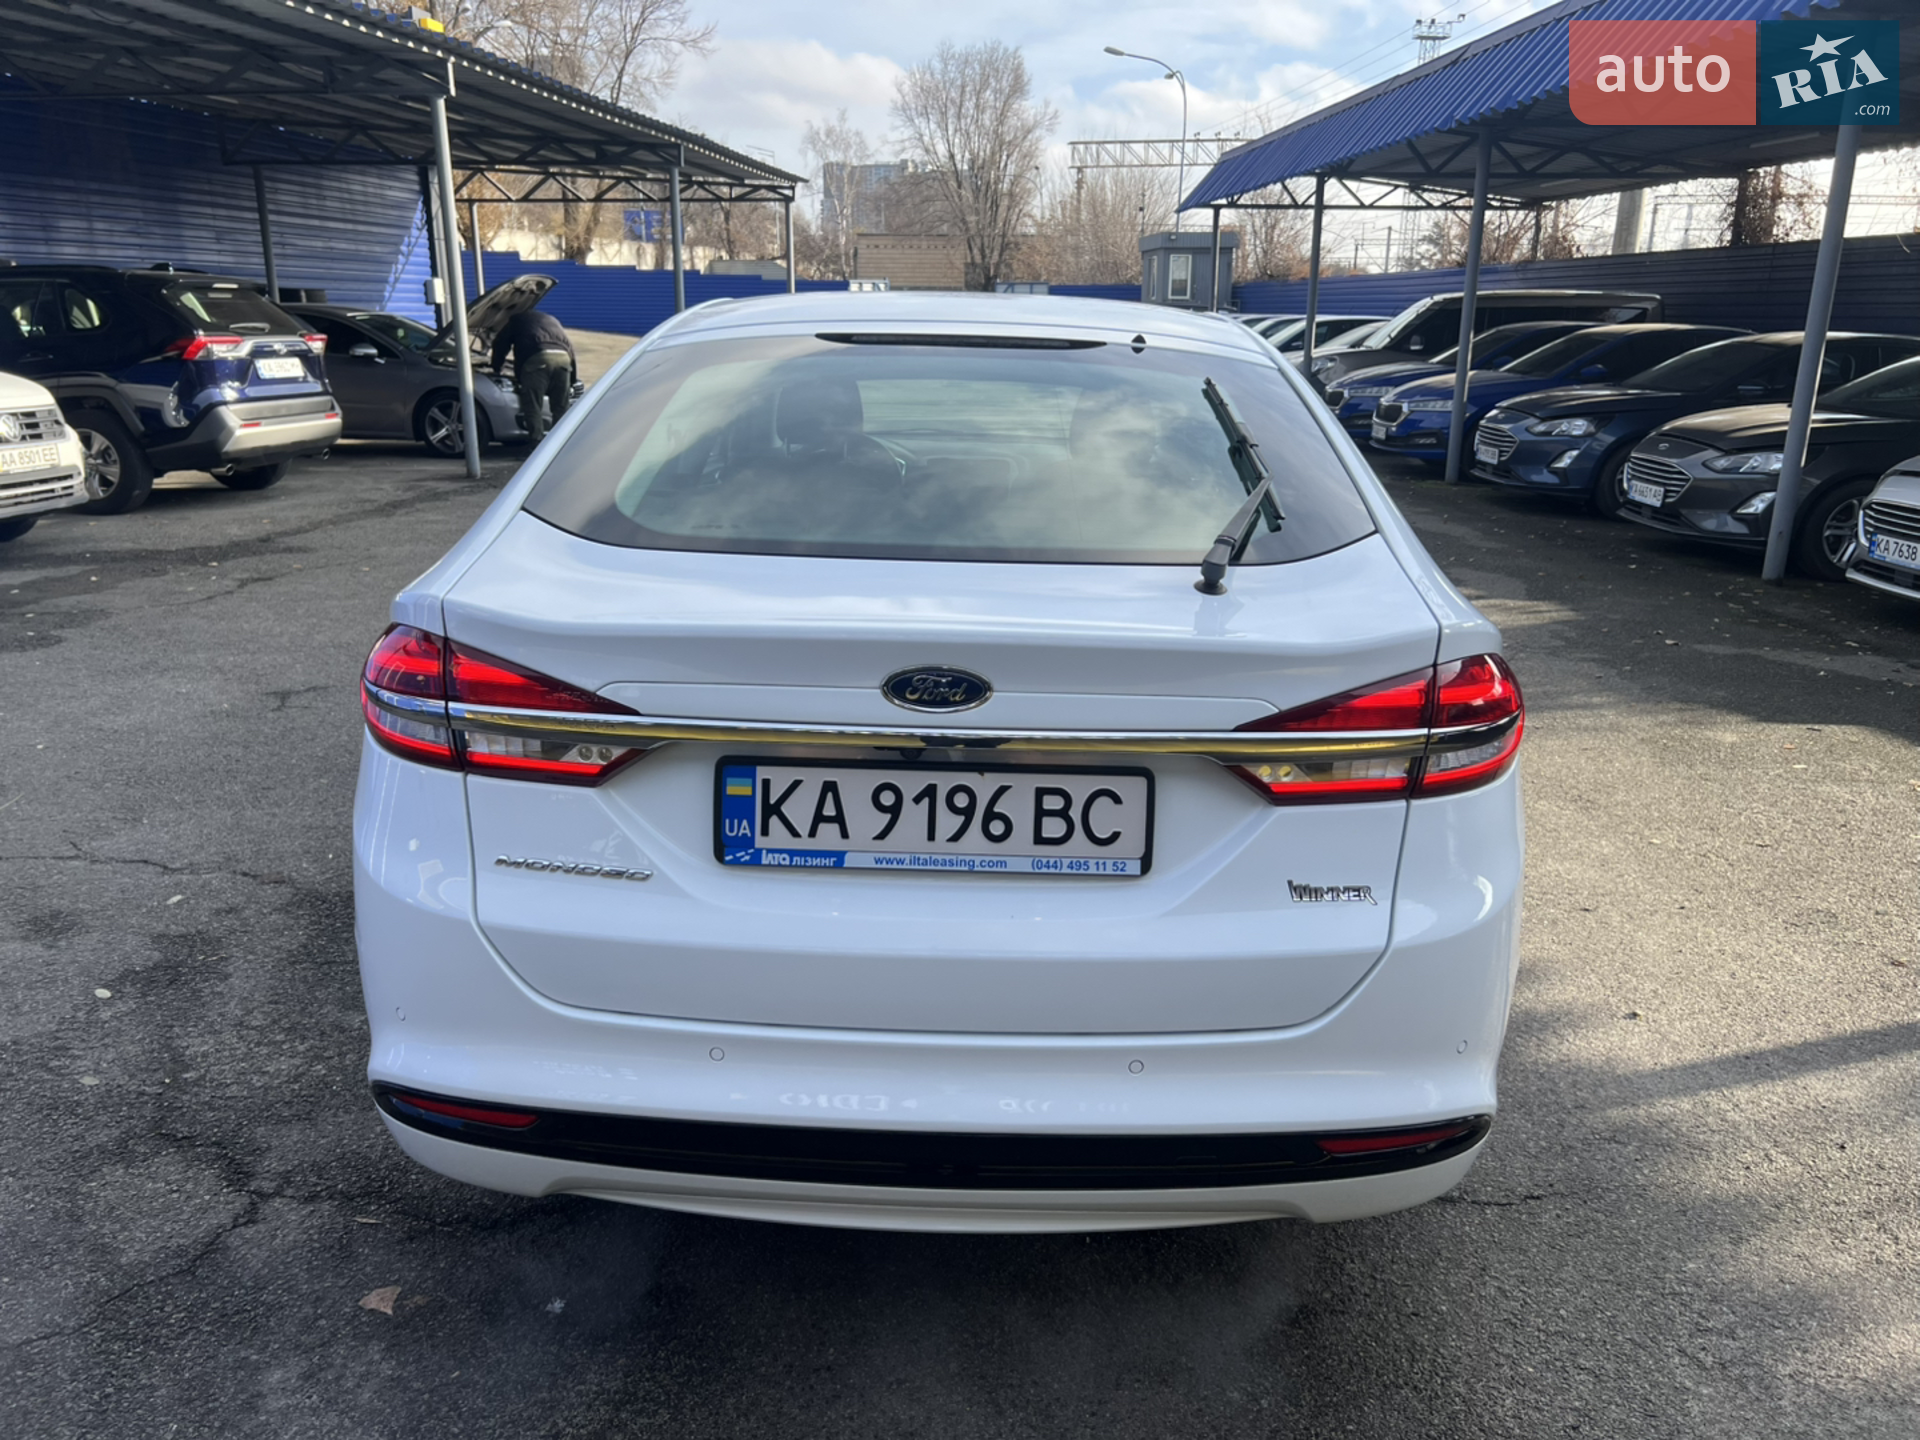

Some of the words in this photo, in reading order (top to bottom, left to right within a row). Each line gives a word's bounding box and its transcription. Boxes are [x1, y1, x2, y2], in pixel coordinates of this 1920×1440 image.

[41, 447, 57, 462] EE
[1877, 537, 1890, 555] KA
[1891, 540, 1918, 562] 7638
[905, 674, 968, 701] Ford
[760, 778, 850, 840] KA
[870, 781, 1014, 844] 9196
[1032, 786, 1124, 847] BC
[725, 818, 752, 837] UA
[494, 854, 654, 882] MONDEO
[873, 855, 1008, 872] www.iltaleasing.com
[1031, 858, 1064, 871] (044)
[1066, 860, 1090, 871] 495
[1094, 861, 1108, 872] 11
[1111, 861, 1127, 872] 52
